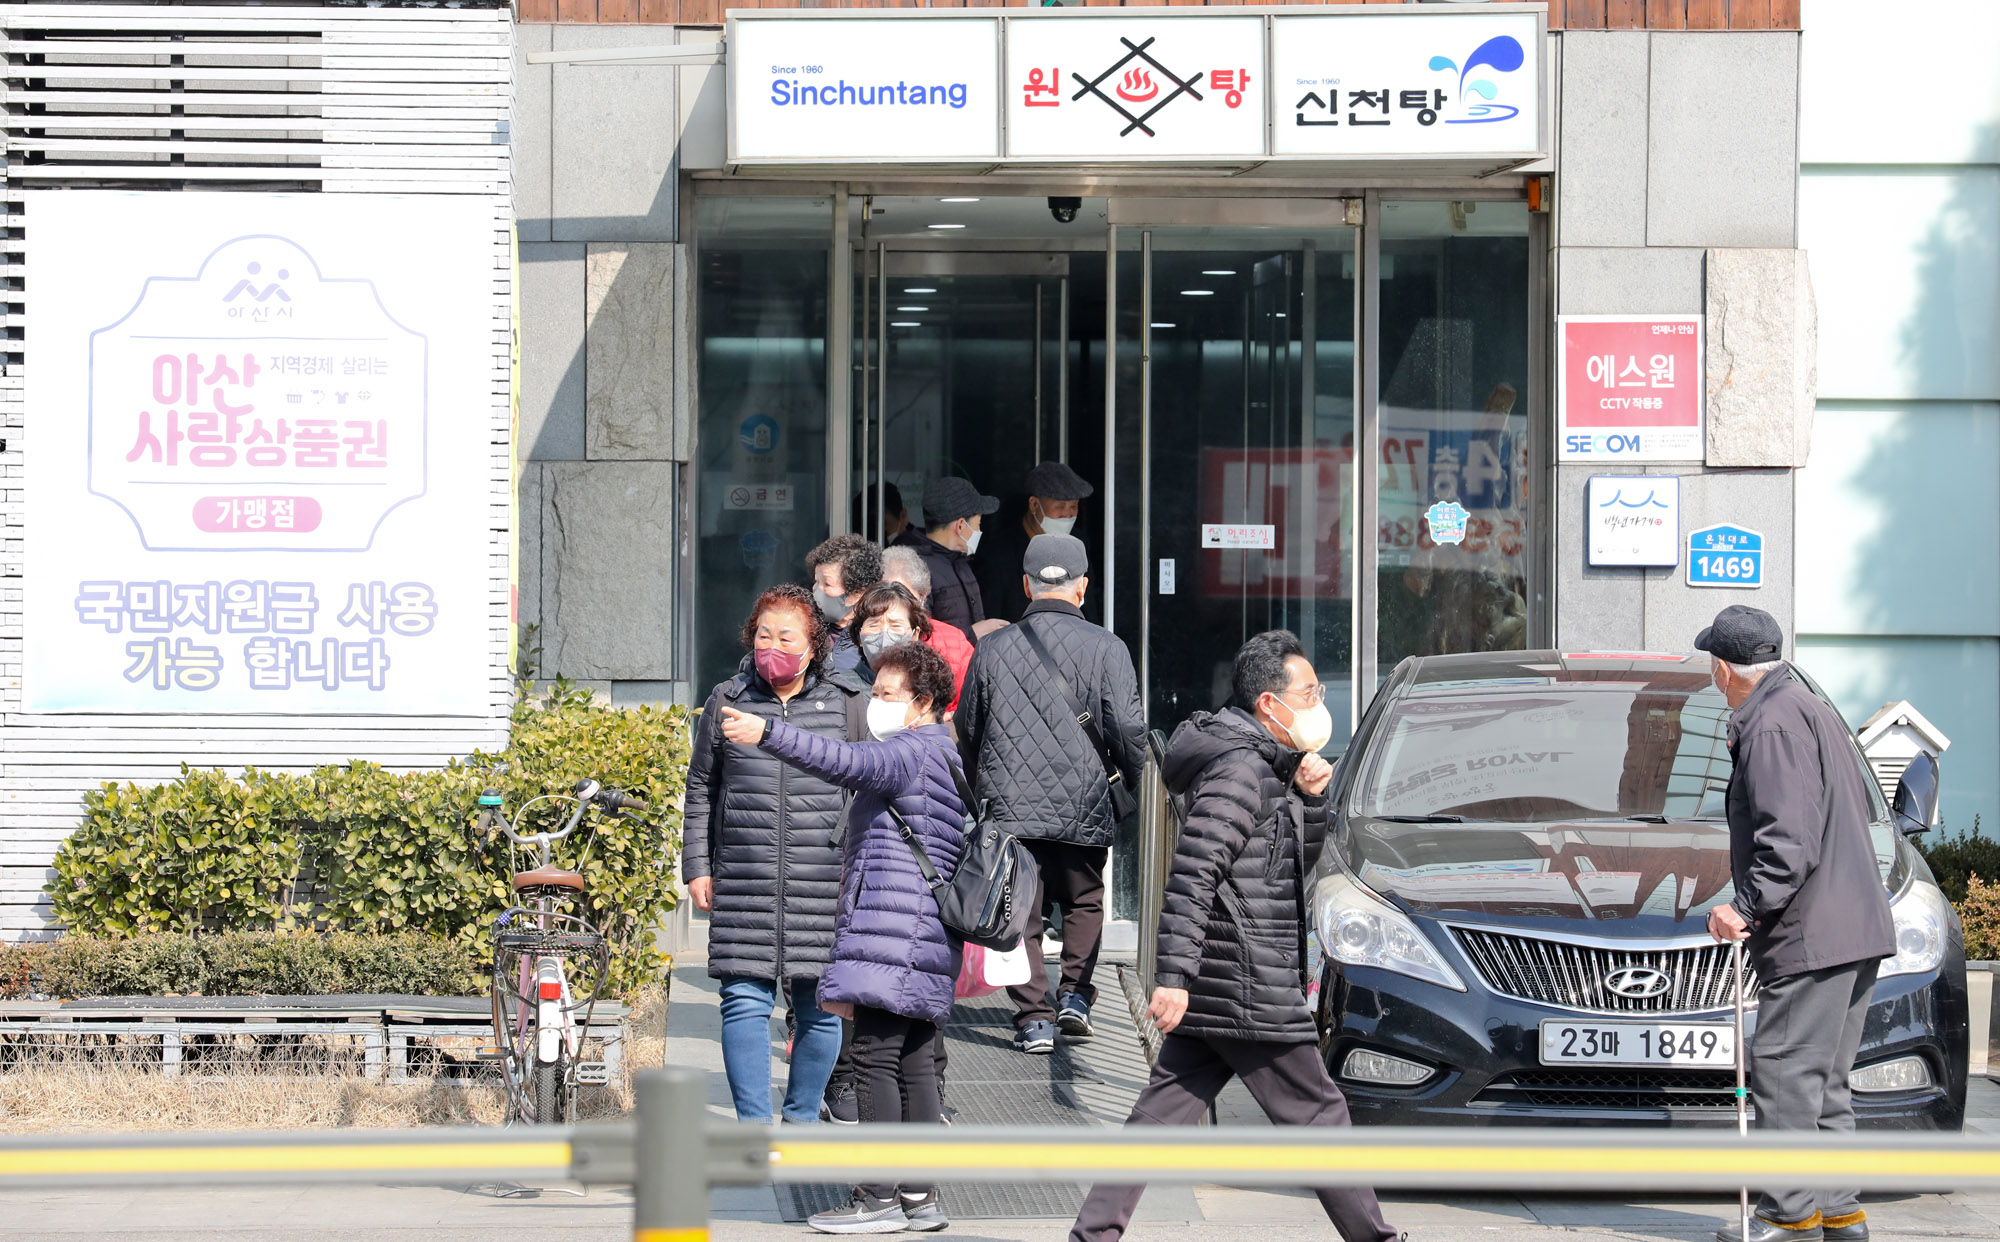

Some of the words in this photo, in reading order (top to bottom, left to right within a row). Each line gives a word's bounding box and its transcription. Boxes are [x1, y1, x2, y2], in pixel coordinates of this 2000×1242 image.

[771, 65, 797, 74] Since
[801, 65, 824, 74] 1960
[771, 79, 967, 109] Sinchuntang
[1023, 68, 1060, 107] 원
[1210, 68, 1251, 109] 탕
[1296, 89, 1448, 126] 신천탕
[227, 306, 293, 323] 아산시
[1651, 325, 1676, 335] 언제나
[1678, 325, 1695, 335] 안심
[270, 356, 334, 376] 지역경제
[341, 356, 389, 376] 살리는
[1586, 354, 1675, 389] 에스원
[152, 353, 261, 414] 아산
[1600, 398, 1631, 409] CCTV
[1632, 398, 1664, 409] 작동중
[125, 410, 388, 468] 사랑상품권
[1566, 434, 1641, 453] SECOM
[756, 488, 787, 501] 금연
[216, 498, 296, 529] 가맹점
[1227, 528, 1269, 544] 머리조심
[1698, 556, 1754, 578] 1469
[75, 580, 319, 634] 국민지원금
[337, 581, 438, 636] 사용
[124, 637, 223, 690] 가능
[245, 637, 391, 691] 합니다
[1561, 1028, 1620, 1057] 23마
[1640, 1030, 1717, 1059] 1849
